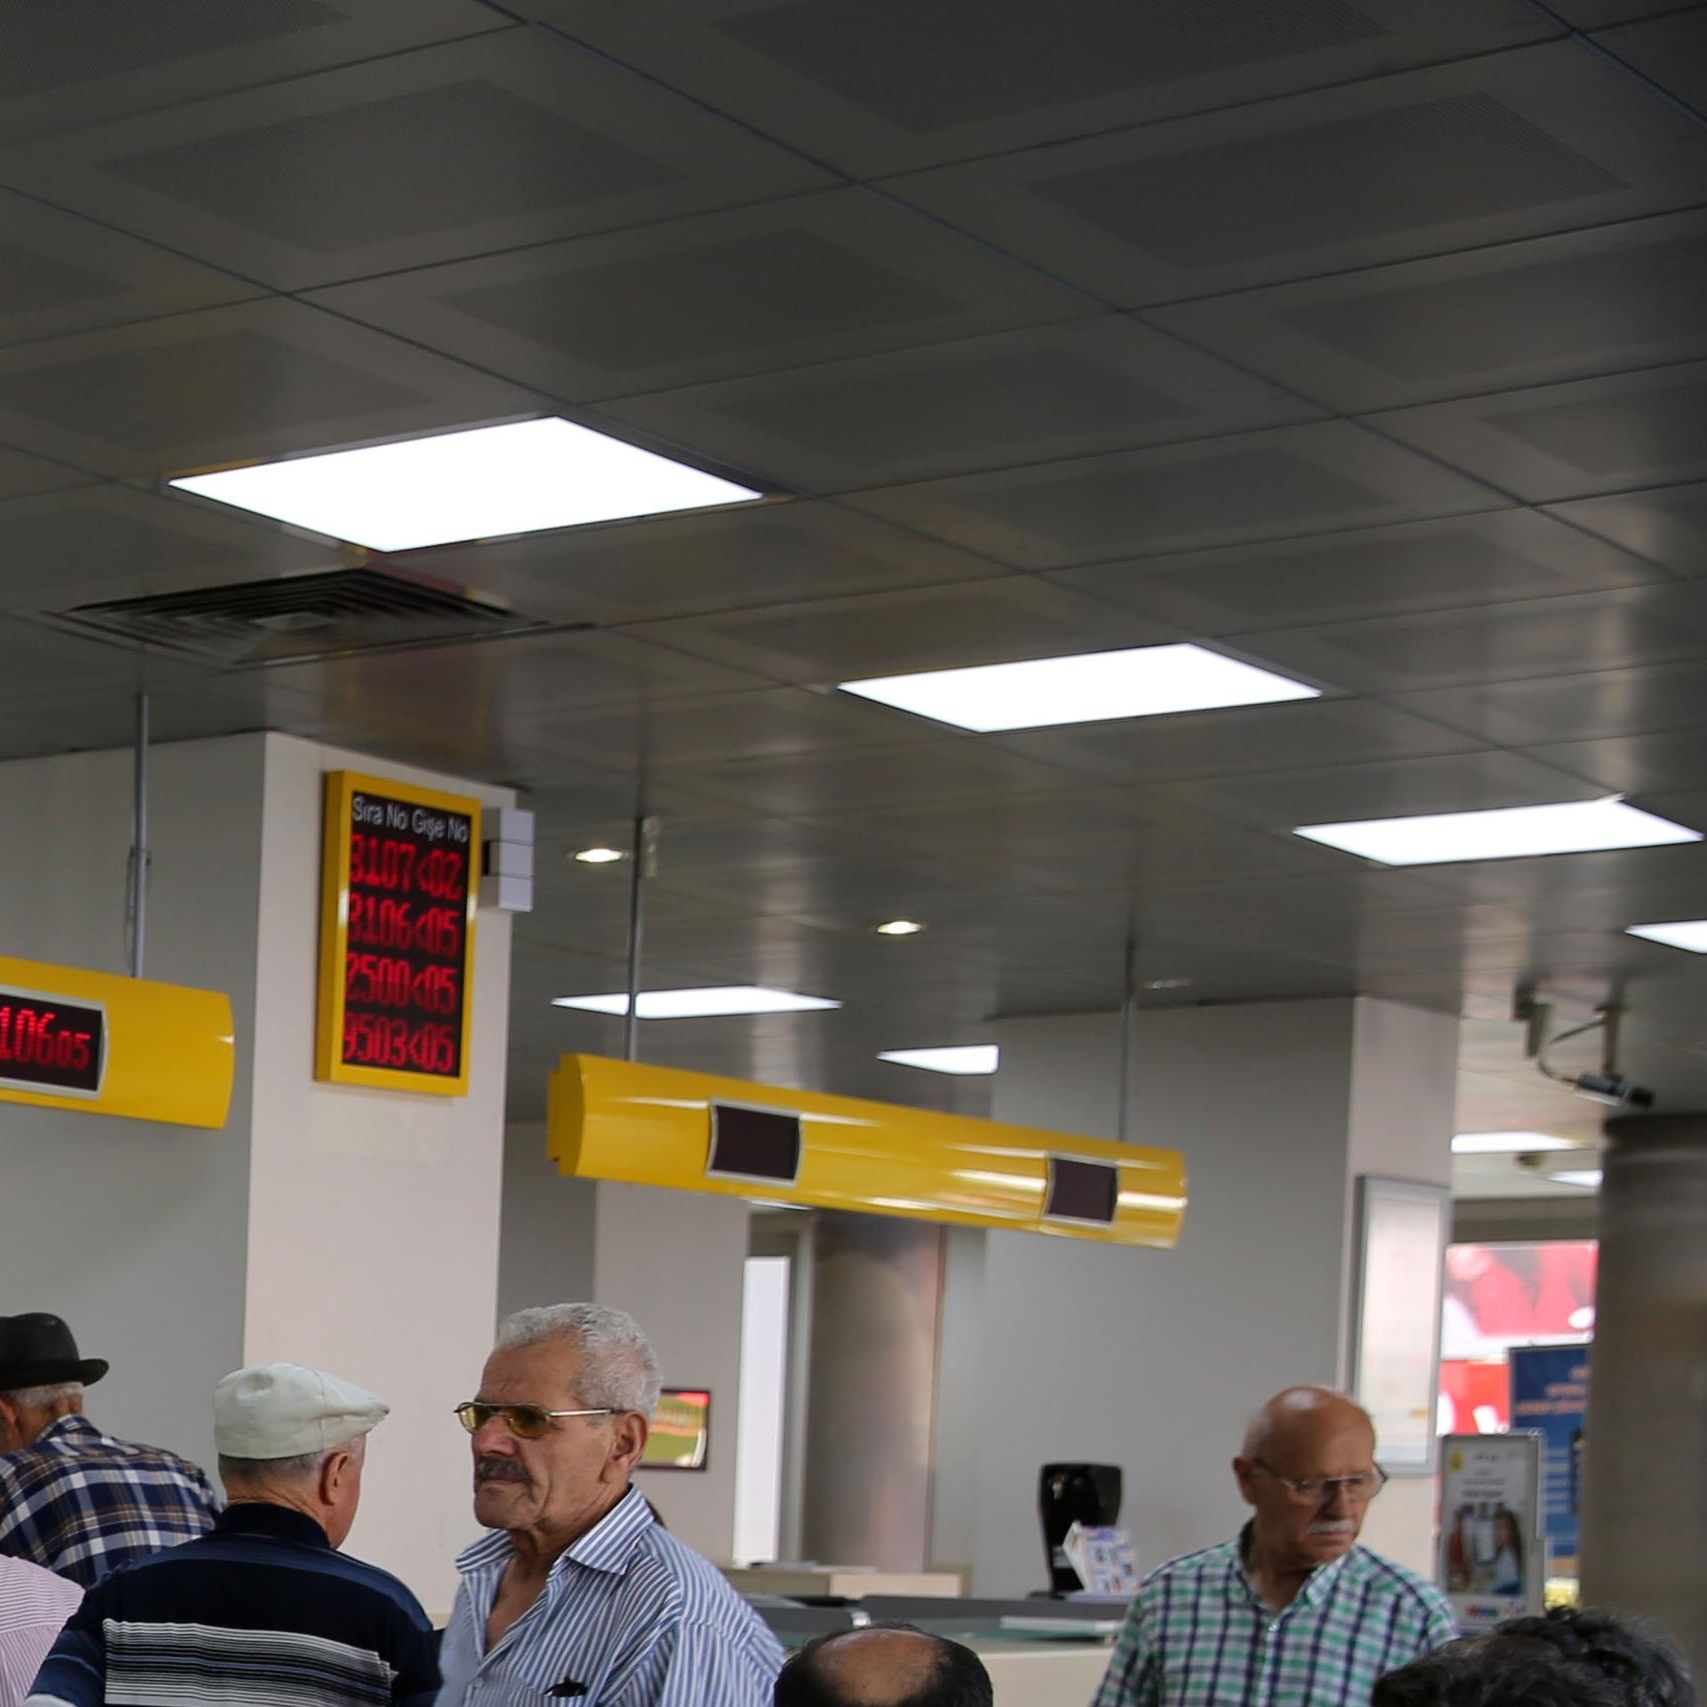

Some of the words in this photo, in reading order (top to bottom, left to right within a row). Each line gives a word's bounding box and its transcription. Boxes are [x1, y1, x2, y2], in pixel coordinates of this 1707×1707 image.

[353, 796, 383, 825] Sıra
[386, 804, 409, 830] No
[448, 817, 469, 843] No
